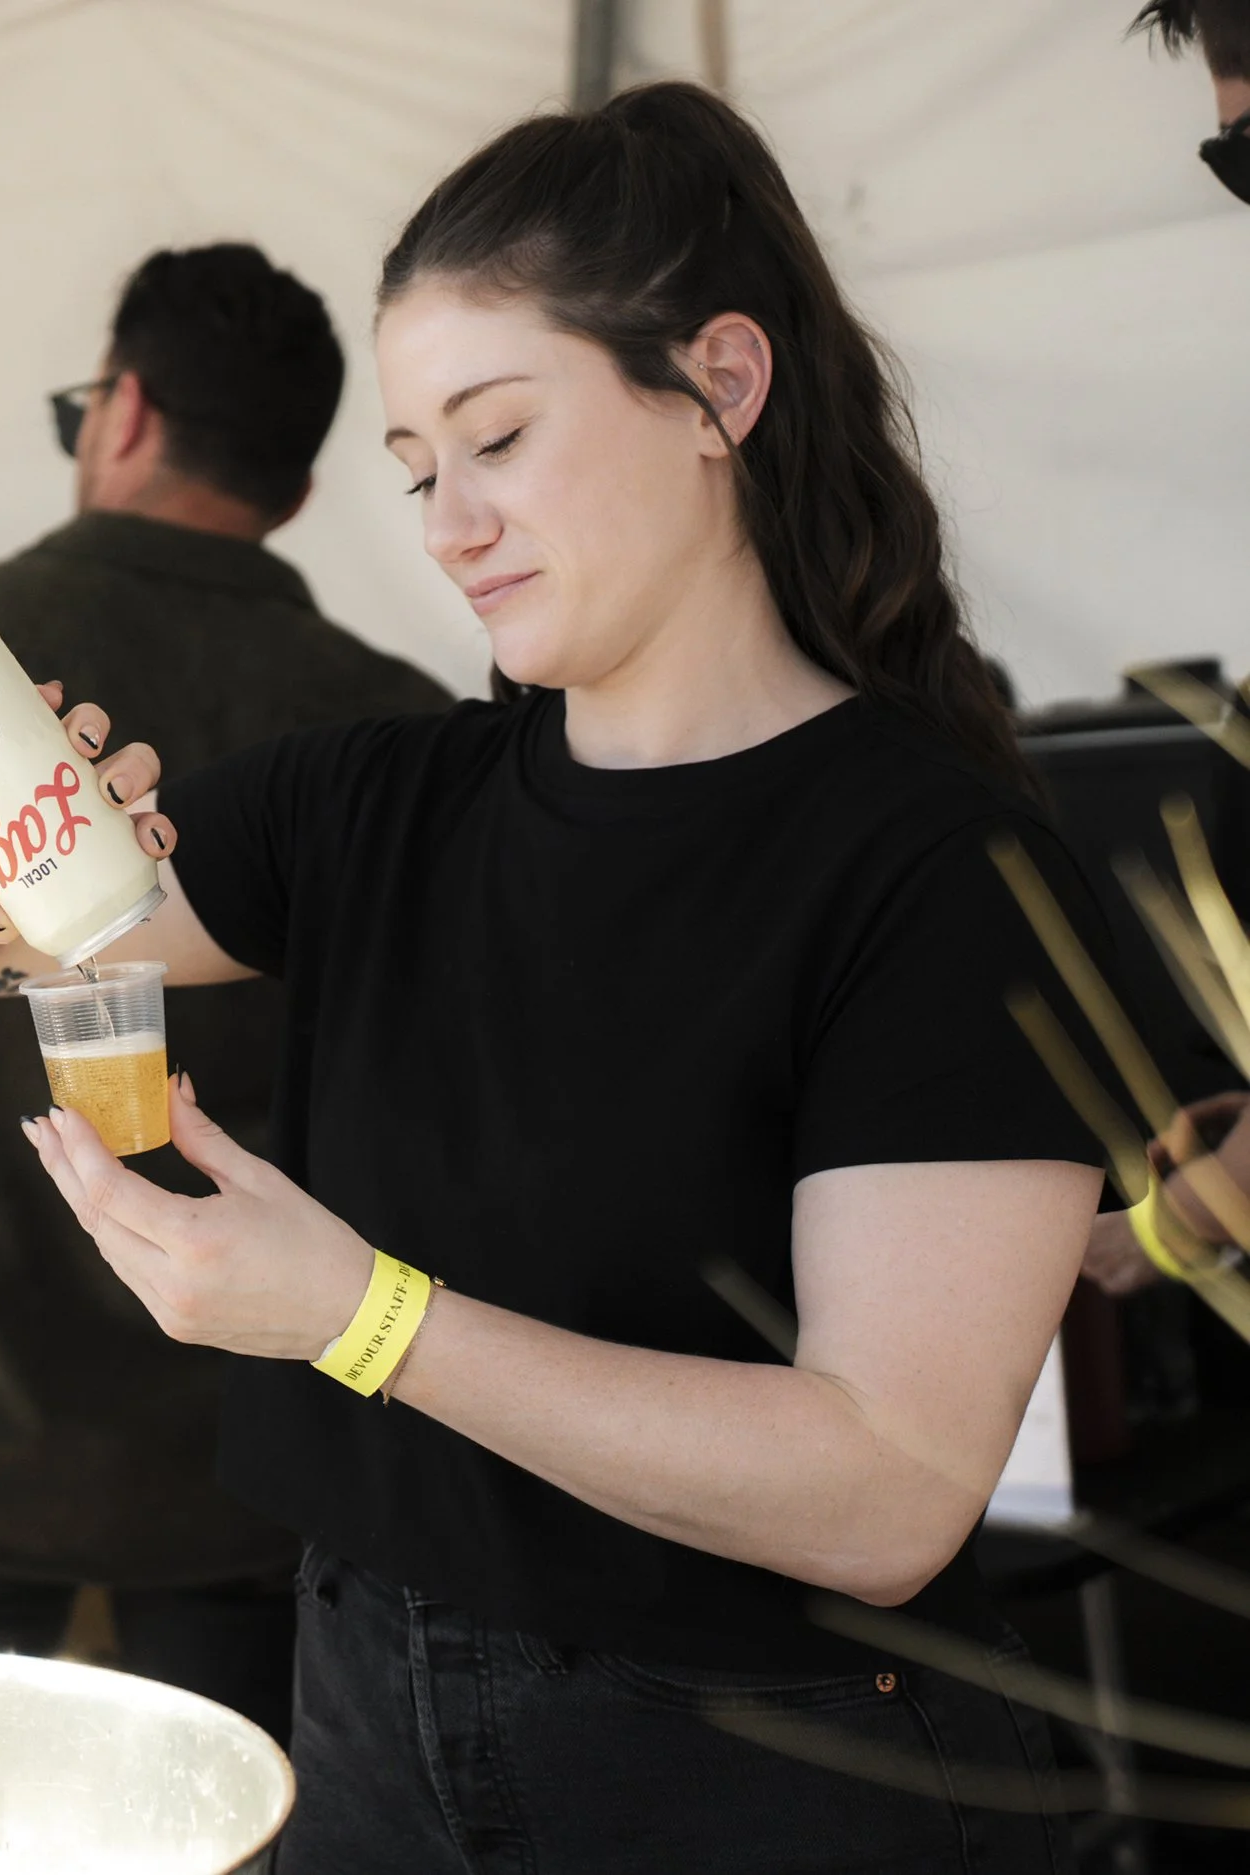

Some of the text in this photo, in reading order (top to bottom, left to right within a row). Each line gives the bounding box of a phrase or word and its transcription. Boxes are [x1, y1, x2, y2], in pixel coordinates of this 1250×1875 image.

[18, 858, 58, 889] LOCAL
[345, 1334, 386, 1381] DEVOUR
[379, 1282, 410, 1334] STAFF
